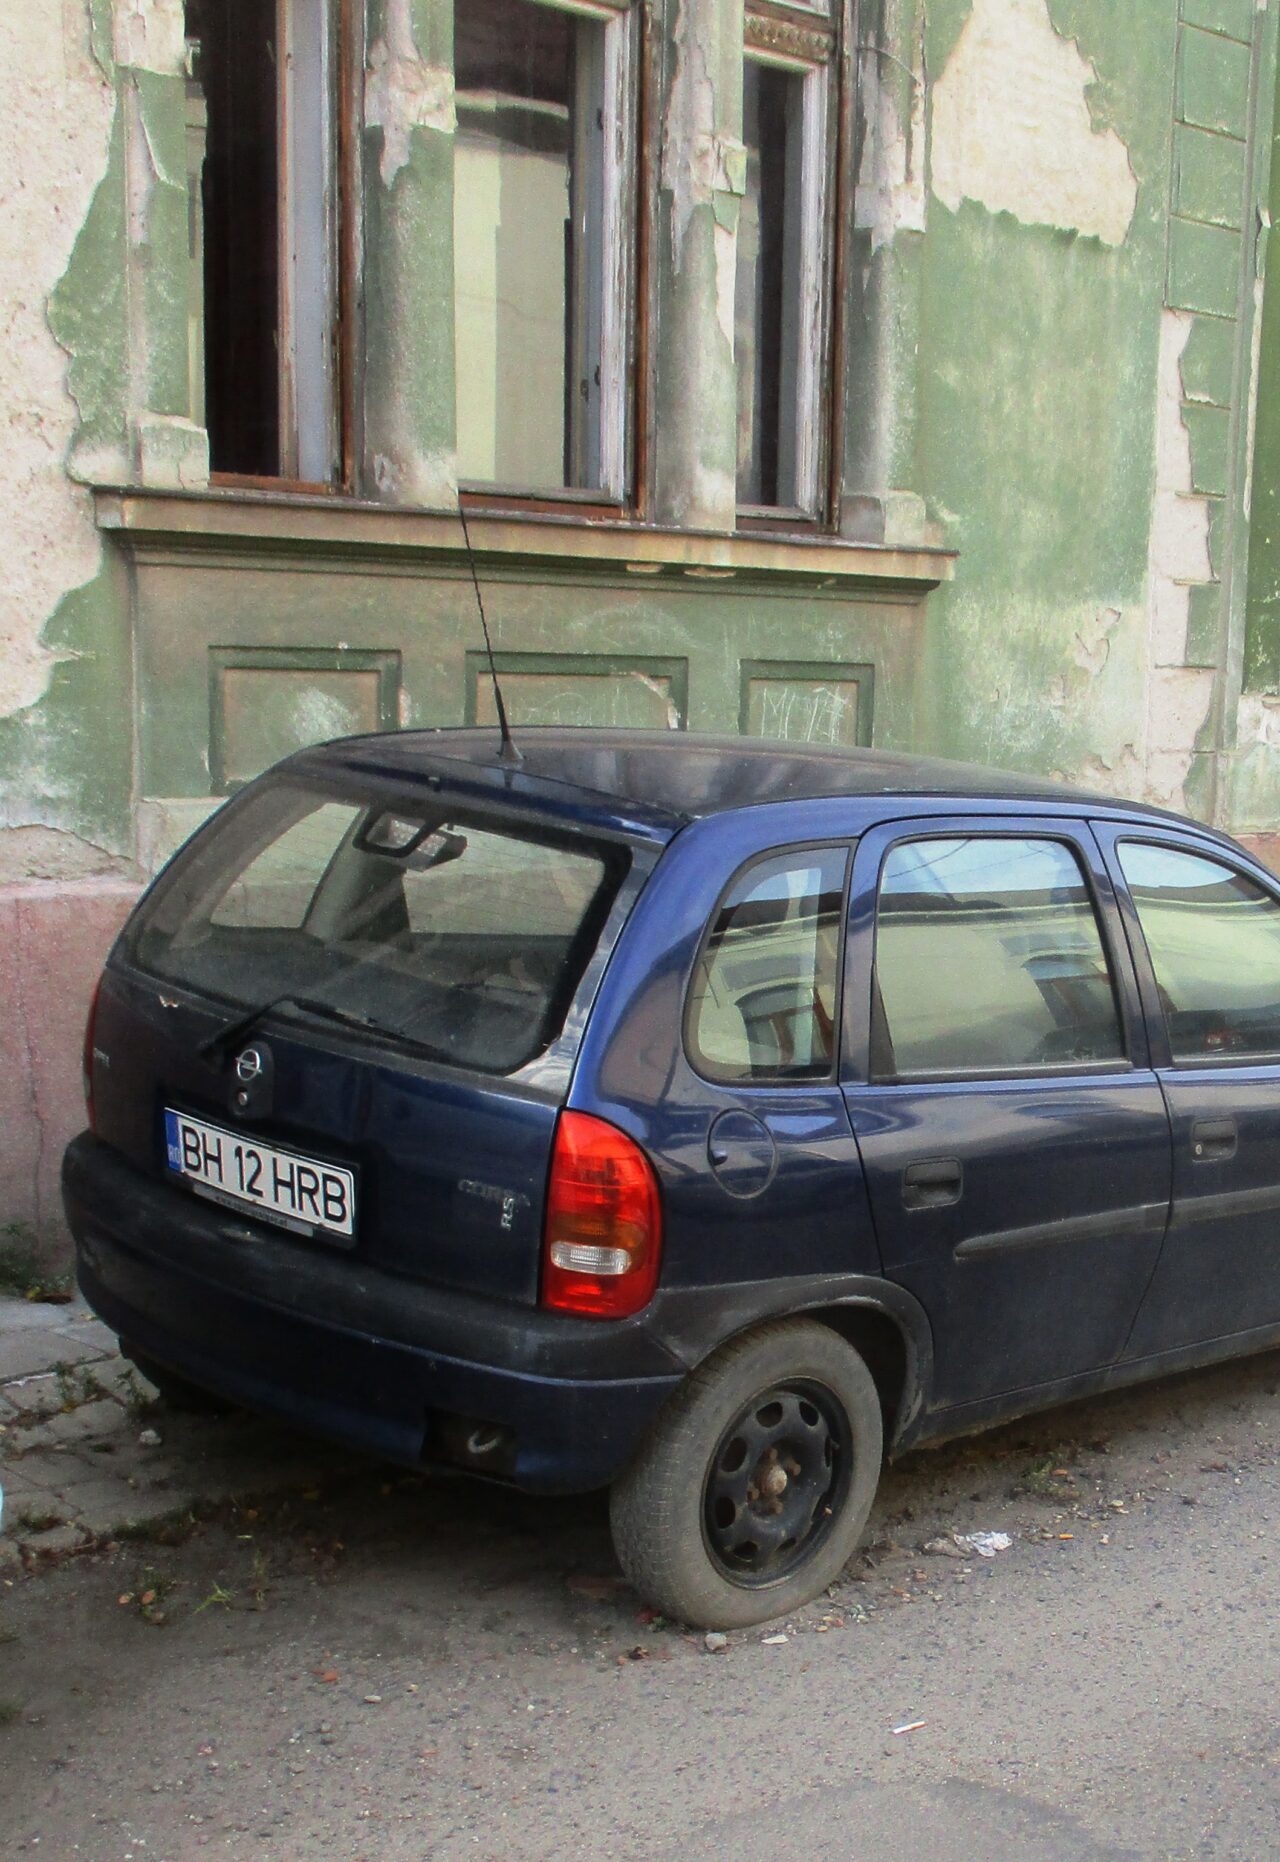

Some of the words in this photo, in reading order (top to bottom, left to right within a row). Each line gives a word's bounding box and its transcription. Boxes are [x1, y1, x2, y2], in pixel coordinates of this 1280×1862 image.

[181, 1124, 223, 1183] BH
[234, 1144, 264, 1198] 12
[272, 1156, 347, 1224] HRB
